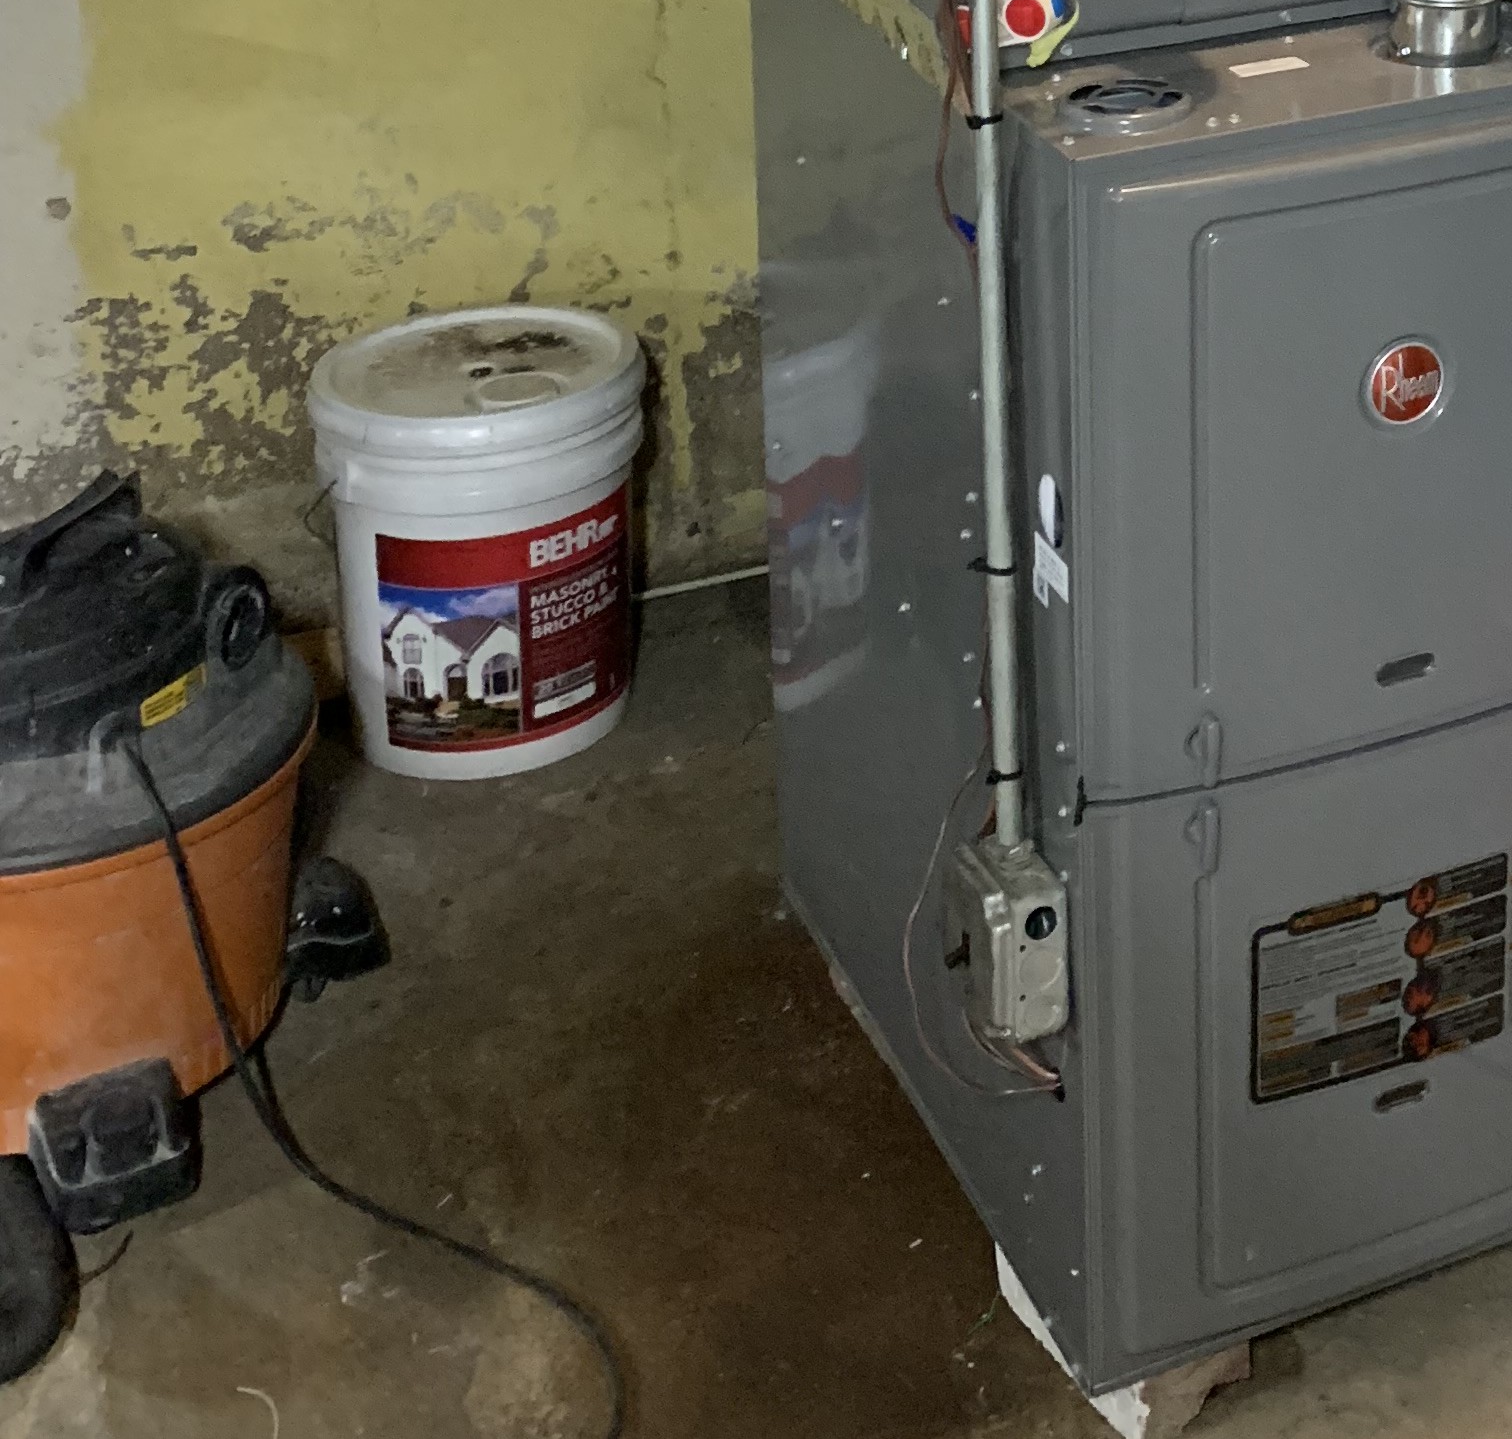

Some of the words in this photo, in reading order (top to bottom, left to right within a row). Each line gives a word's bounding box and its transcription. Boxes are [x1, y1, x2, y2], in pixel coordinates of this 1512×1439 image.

[1381, 352, 1439, 413] Rheem
[529, 518, 599, 568] BEHR
[531, 589, 596, 625] STUCCO
[532, 611, 581, 639] BRICK
